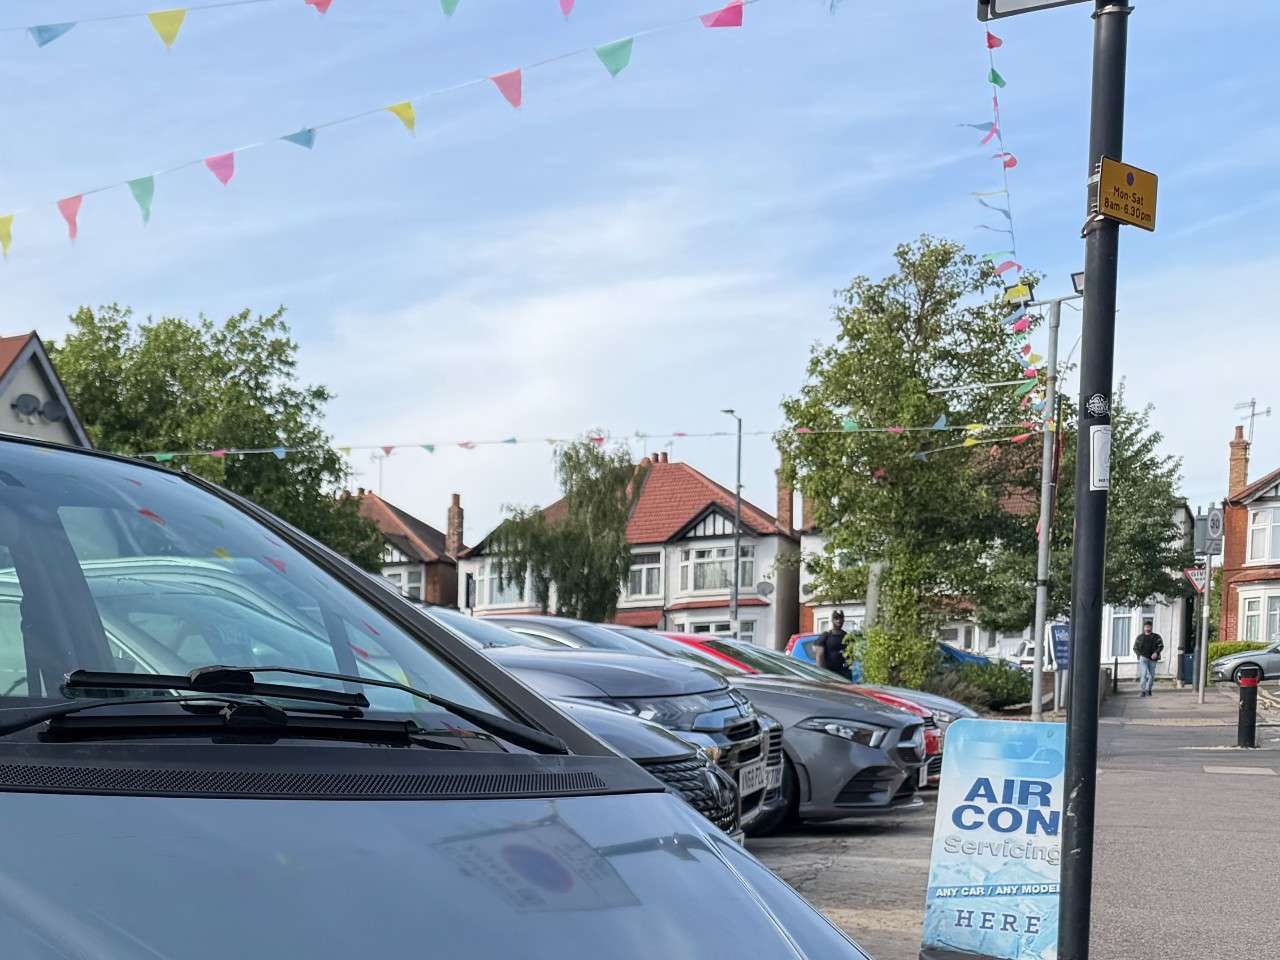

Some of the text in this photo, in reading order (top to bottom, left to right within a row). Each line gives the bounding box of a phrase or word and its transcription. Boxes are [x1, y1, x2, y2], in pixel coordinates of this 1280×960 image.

[964, 777, 1052, 807] AIR
[951, 804, 1060, 836] CON
[943, 836, 1060, 865] Servicing
[936, 888, 958, 898] ANY
[961, 887, 985, 897] CAR
[995, 886, 1019, 896] ANY
[955, 909, 1041, 935] HERE
